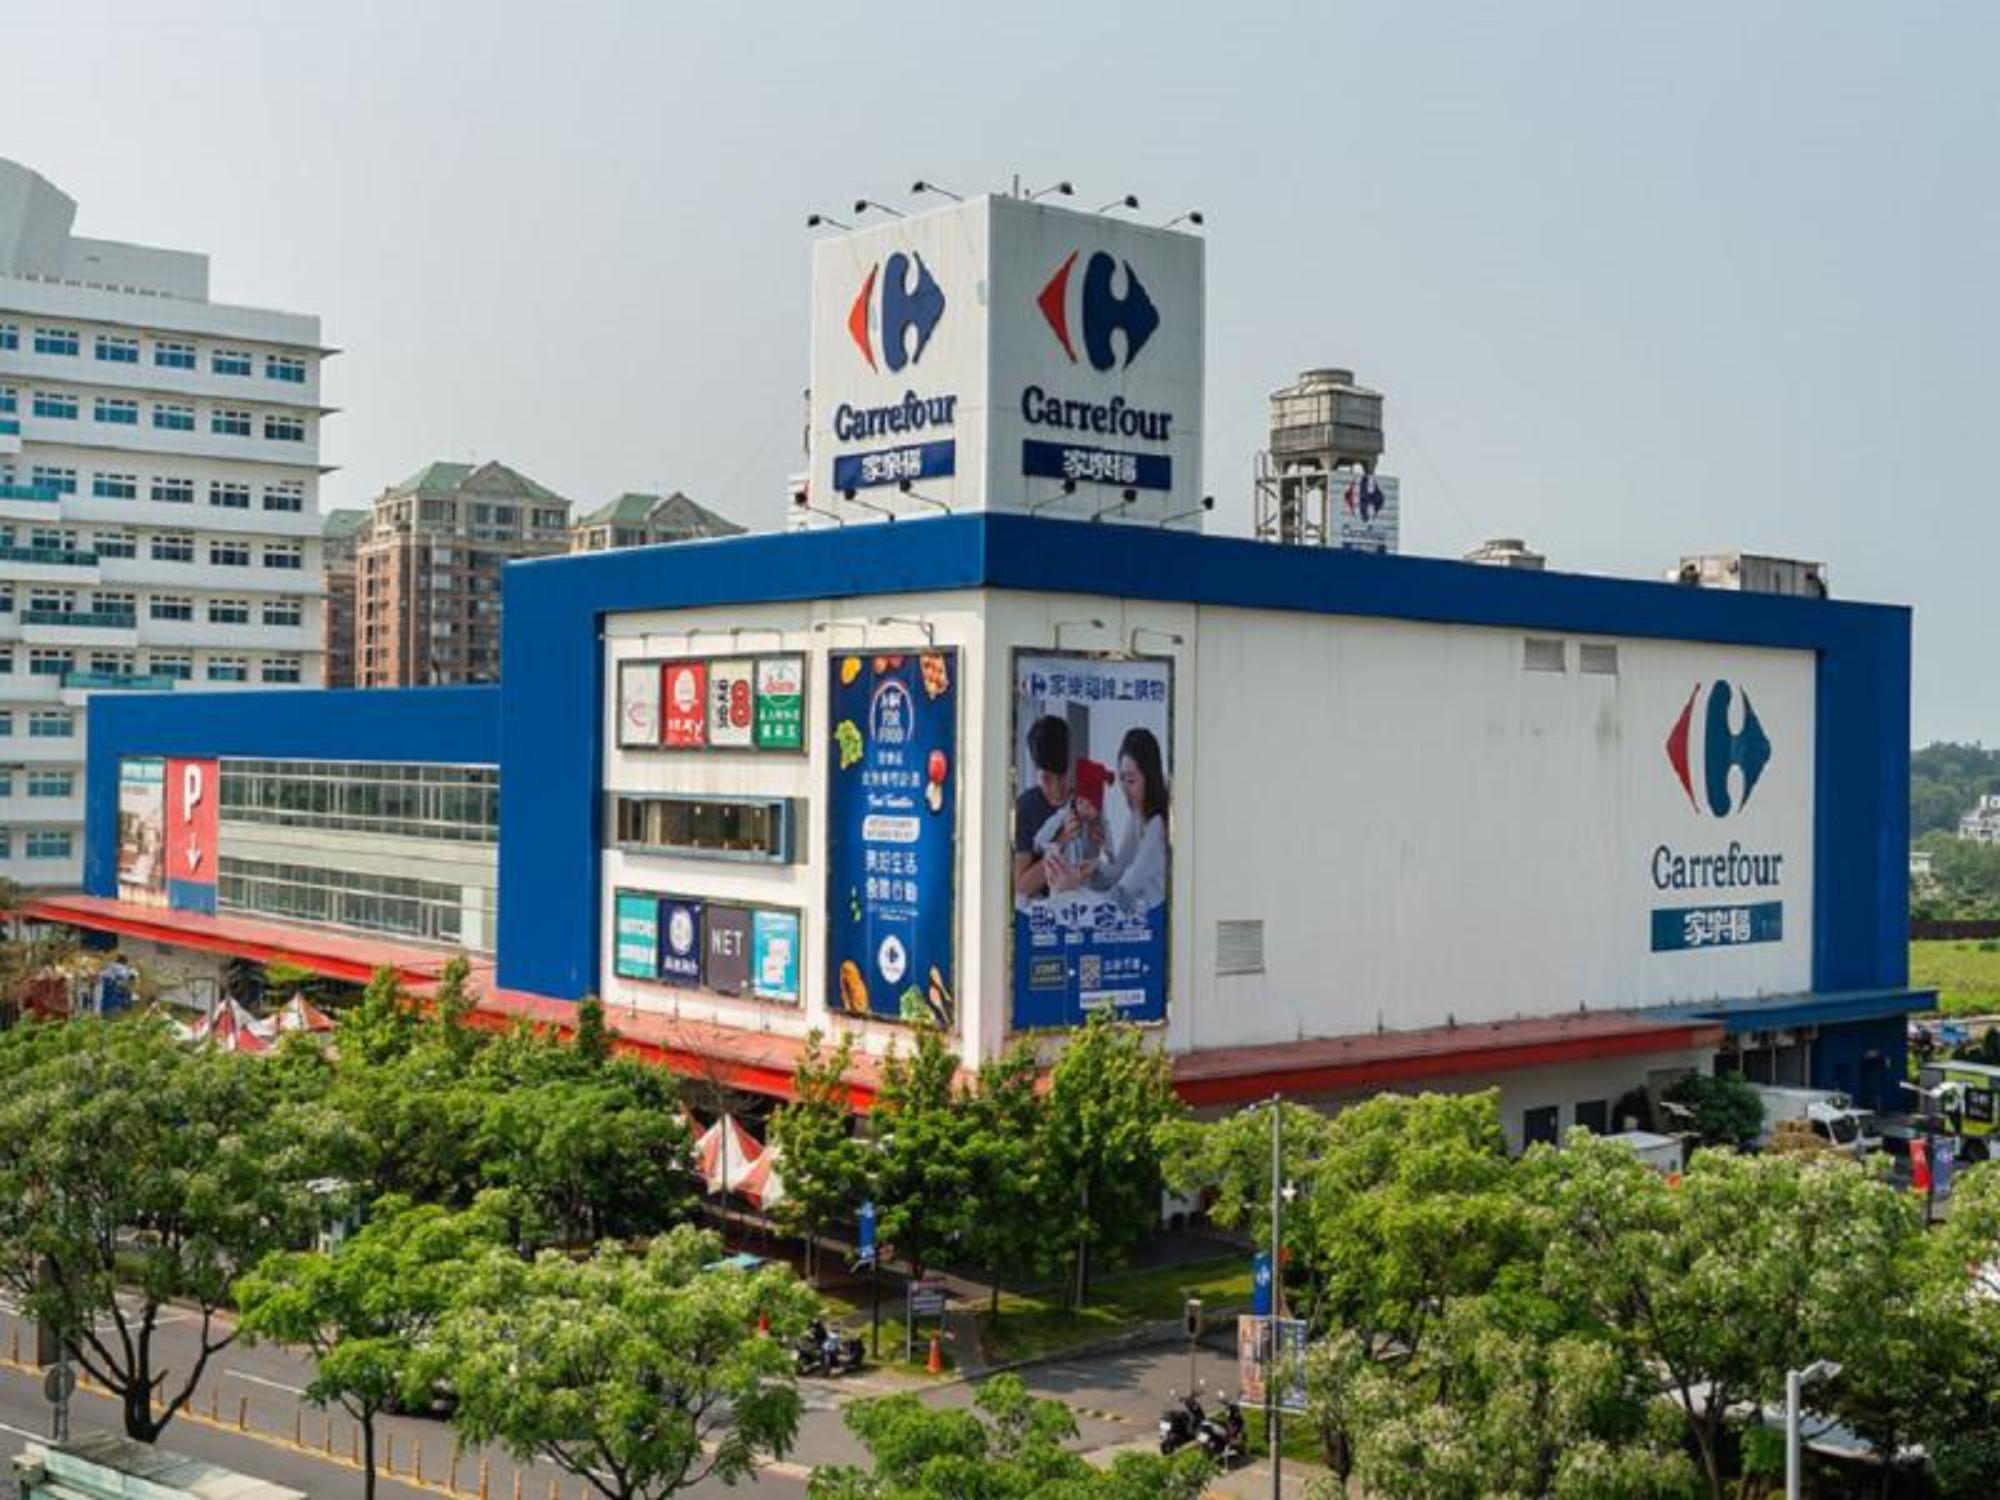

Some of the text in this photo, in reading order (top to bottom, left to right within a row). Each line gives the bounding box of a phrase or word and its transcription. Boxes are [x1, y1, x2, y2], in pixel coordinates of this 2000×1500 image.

[835, 390, 957, 441] Carrefour
[1022, 385, 1172, 440] Carrefour
[184, 764, 203, 822] P
[1652, 841, 1783, 889] Carrefour
[711, 928, 744, 957] NET
